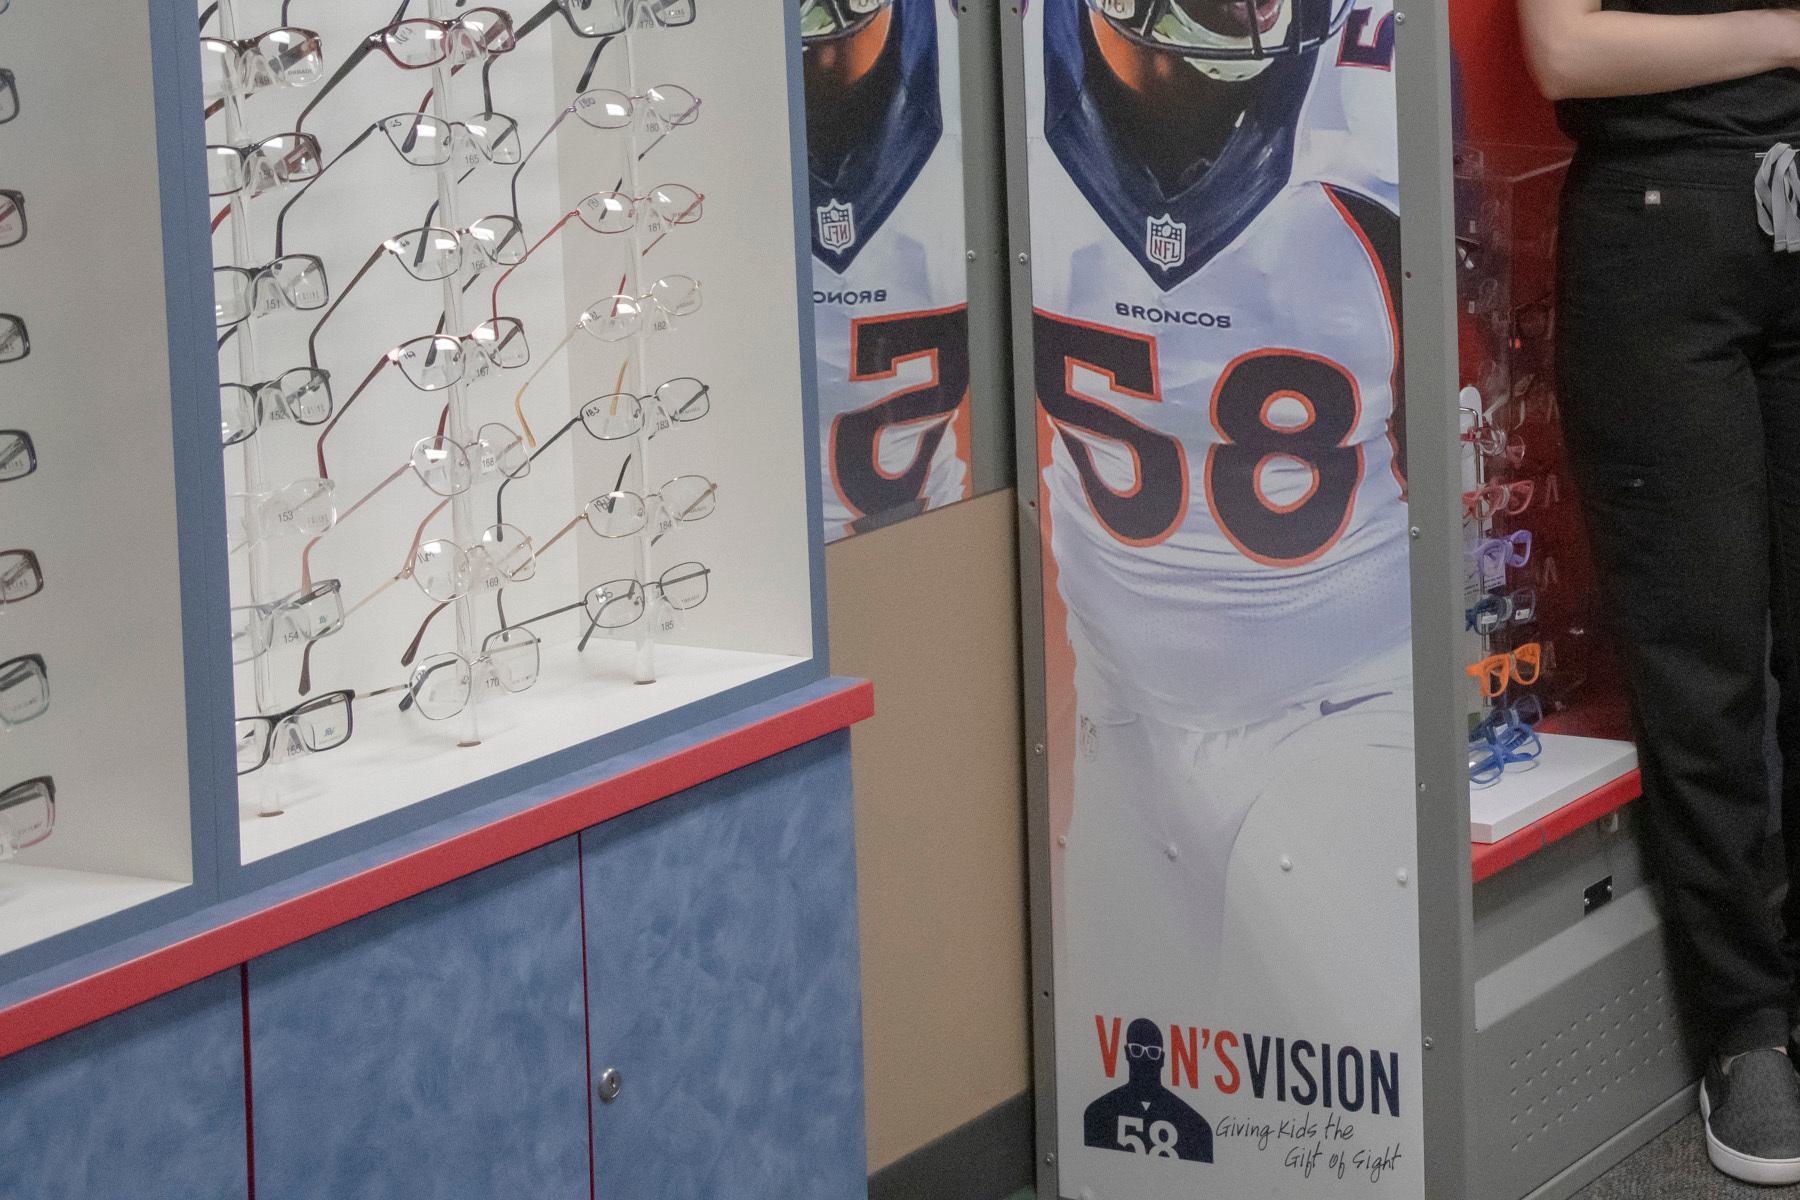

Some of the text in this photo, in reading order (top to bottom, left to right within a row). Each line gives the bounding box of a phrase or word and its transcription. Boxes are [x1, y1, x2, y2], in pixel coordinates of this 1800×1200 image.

[646, 123, 659, 132] 180
[465, 154, 480, 165] 165
[648, 223, 661, 232] 181
[1152, 238, 1181, 262] NFL
[471, 260, 486, 271] 166
[266, 298, 281, 309] 151
[1115, 302, 1232, 329] BRONCOS
[653, 322, 667, 332] 182
[476, 366, 490, 377] 167
[270, 409, 286, 421] 152
[656, 419, 669, 430] 183
[1033, 308, 1365, 568] 58
[481, 456, 495, 468] 168
[277, 511, 294, 523] 153
[659, 520, 672, 531] 184
[485, 576, 499, 588] 169
[661, 620, 674, 631] 185
[284, 631, 299, 644] 154
[485, 678, 500, 689] 170
[1215, 1112, 1354, 1150] Giving Kids the
[1117, 1115, 1180, 1160] 58
[1284, 1141, 1402, 1183] Gift of Sight
